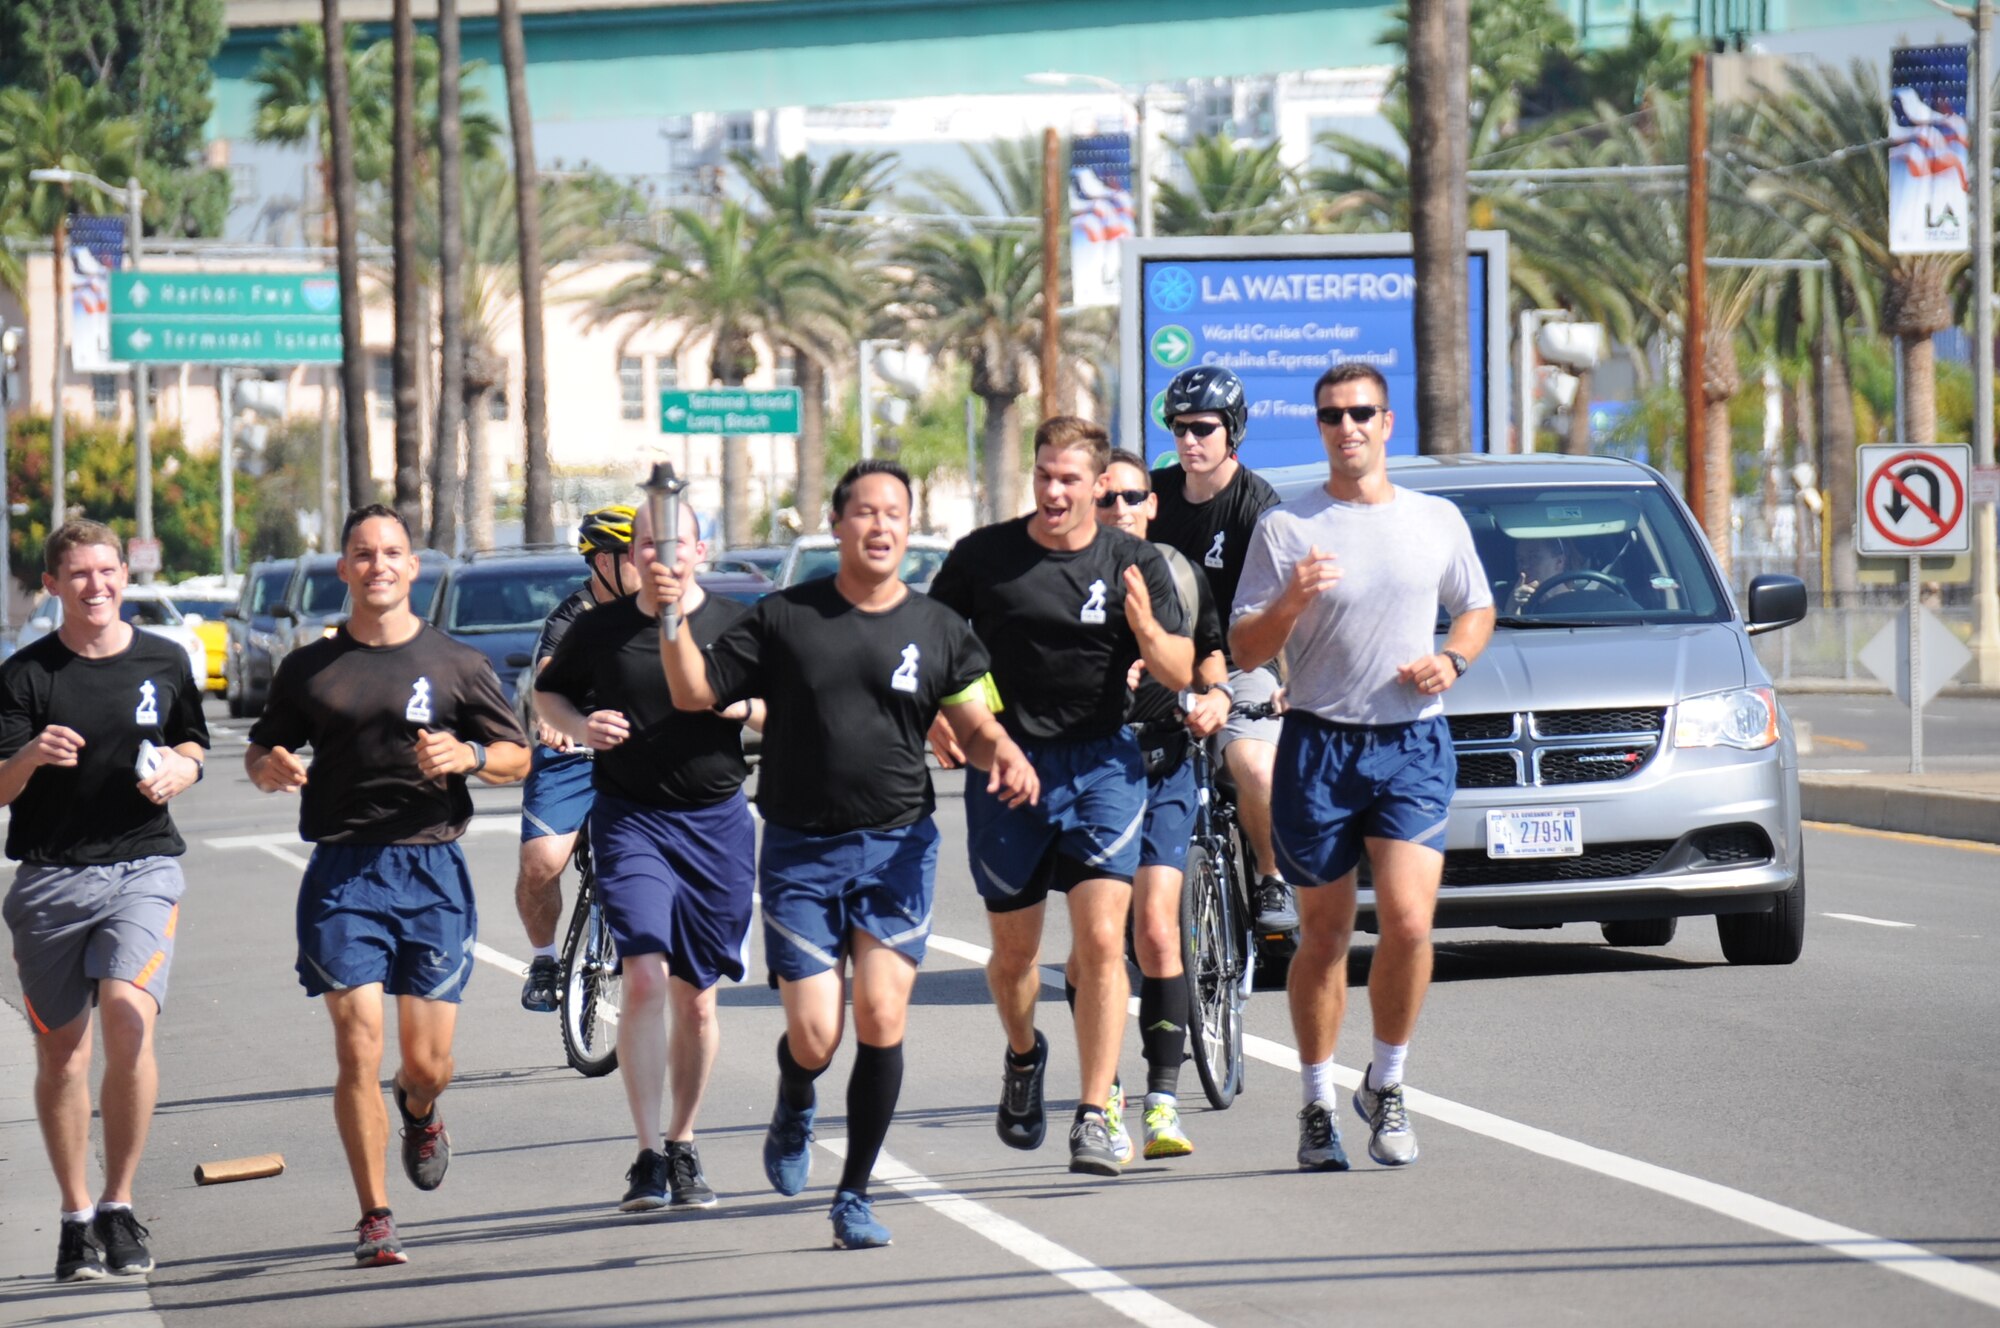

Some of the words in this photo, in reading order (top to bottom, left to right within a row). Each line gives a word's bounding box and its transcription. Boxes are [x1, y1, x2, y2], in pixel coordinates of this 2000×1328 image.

[1925, 202, 1960, 228] LA
[1202, 275, 1241, 303] LA
[1242, 273, 1418, 302] WATERFRON
[163, 328, 263, 349] Terminal
[1202, 322, 1250, 342] World
[1250, 322, 1302, 341] Cruise
[1302, 321, 1360, 341] Center
[1202, 350, 1267, 368] Catalina
[1267, 349, 1329, 372] Express
[1328, 348, 1397, 367] Terminal
[1272, 399, 1318, 417] Freew
[1520, 819, 1573, 844] 2795N
